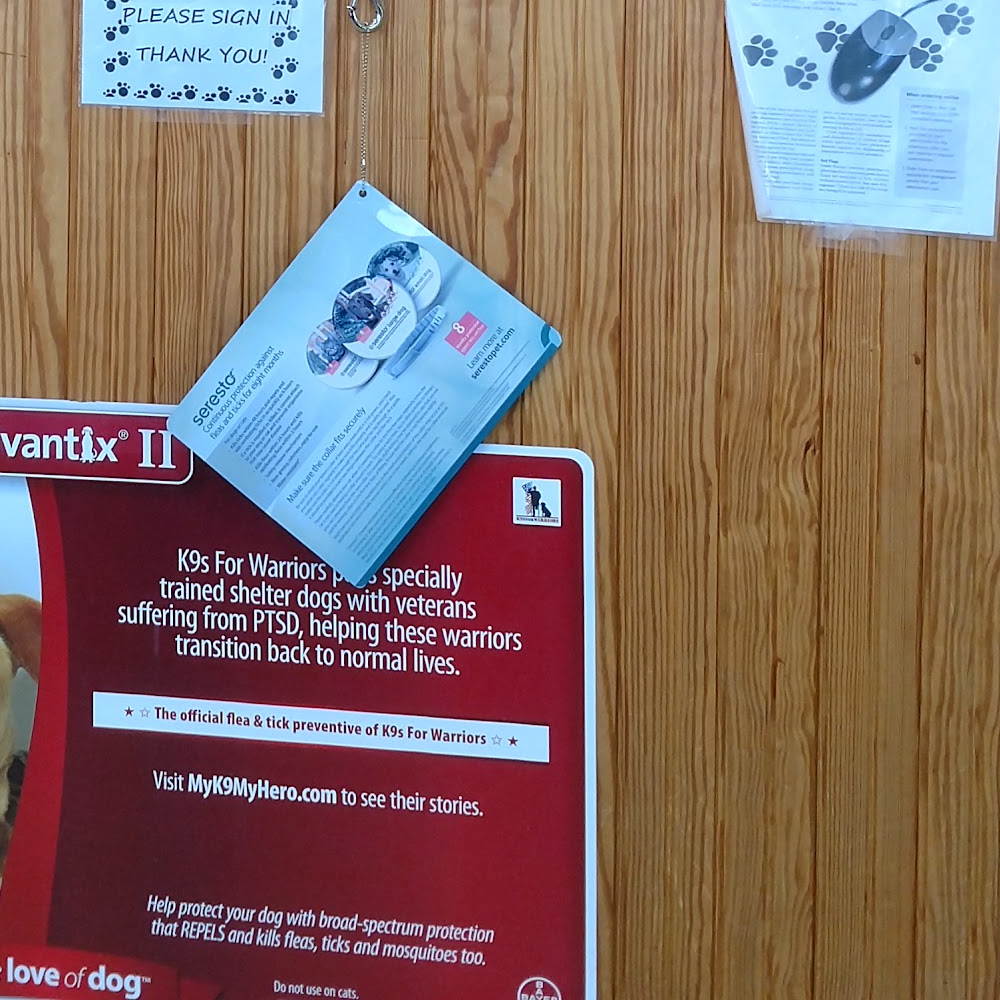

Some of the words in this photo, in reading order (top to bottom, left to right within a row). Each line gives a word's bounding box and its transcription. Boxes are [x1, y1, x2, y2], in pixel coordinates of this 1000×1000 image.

[123, 7, 205, 24] PLEASE
[212, 9, 260, 25] SIGN
[269, 9, 290, 26] IN
[136, 46, 212, 62] THANK
[219, 46, 268, 64] YOU!
[466, 349, 484, 368] Learn
[481, 333, 498, 351] more
[495, 326, 503, 334] at
[470, 327, 515, 379] serestopet.com
[191, 370, 237, 427] seresto
[201, 398, 232, 432] Continuous
[229, 366, 257, 401] protection
[255, 345, 274, 369] against
[209, 424, 224, 439] fleas
[222, 410, 234, 425] and
[231, 397, 245, 413] ticks
[242, 387, 252, 398] for
[250, 373, 265, 389] eight
[263, 348, 284, 373] months
[137, 428, 176, 469] II
[286, 483, 303, 503] Make
[301, 470, 314, 486] sure
[311, 459, 323, 472] the
[320, 442, 337, 461] collar
[333, 431, 345, 443] fits
[343, 407, 365, 433] securely
[178, 548, 210, 573] K9s
[215, 551, 244, 575] For
[249, 552, 327, 581] Warriors
[382, 564, 463, 596] specially
[159, 577, 224, 602] trained
[230, 579, 292, 606] shelter
[296, 584, 342, 616] dogs
[347, 589, 390, 614] with
[396, 595, 477, 620] veterans
[118, 601, 198, 634] suffering
[203, 605, 247, 632] from
[253, 609, 303, 639] PTSD,
[309, 612, 379, 647] helping
[385, 618, 437, 646] these
[442, 626, 522, 651] warriors
[175, 634, 261, 661] transition
[267, 638, 311, 665] back
[315, 649, 335, 666] to
[340, 647, 407, 672] normal
[413, 649, 460, 676] lives.
[155, 707, 176, 720] The
[181, 710, 223, 724] official
[227, 713, 250, 726] flea
[254, 715, 262, 727] &
[266, 716, 289, 729] tick
[293, 719, 361, 735] preventive
[365, 723, 379, 736] of
[382, 724, 404, 738] K9s
[407, 727, 427, 740] For
[431, 728, 486, 745] Warriors
[153, 770, 184, 791] Visit
[187, 773, 337, 805] MyK9MyHero.com
[341, 788, 356, 806] to
[361, 792, 386, 808] see
[390, 789, 426, 811] their
[429, 796, 484, 816] stories.
[147, 895, 176, 918] Help
[178, 902, 224, 919] protect
[225, 907, 256, 924] your
[258, 906, 283, 928] dog
[287, 909, 316, 927] with
[319, 910, 424, 937] broad-spectrum
[426, 924, 494, 943] protection
[151, 918, 179, 937] that
[181, 921, 225, 942] REPELS
[228, 927, 254, 944] and
[256, 927, 281, 948] kills
[284, 931, 317, 953] fleas,
[321, 935, 350, 954] ticks
[354, 939, 380, 956] and
[382, 943, 457, 963] mosquitoes
[461, 948, 486, 966] too.
[7, 957, 60, 987] love
[64, 967, 87, 989] of
[273, 980, 286, 993] Do
[288, 982, 304, 994] not
[306, 984, 322, 996] use
[324, 987, 335, 997] on
[338, 986, 359, 1000] cats.
